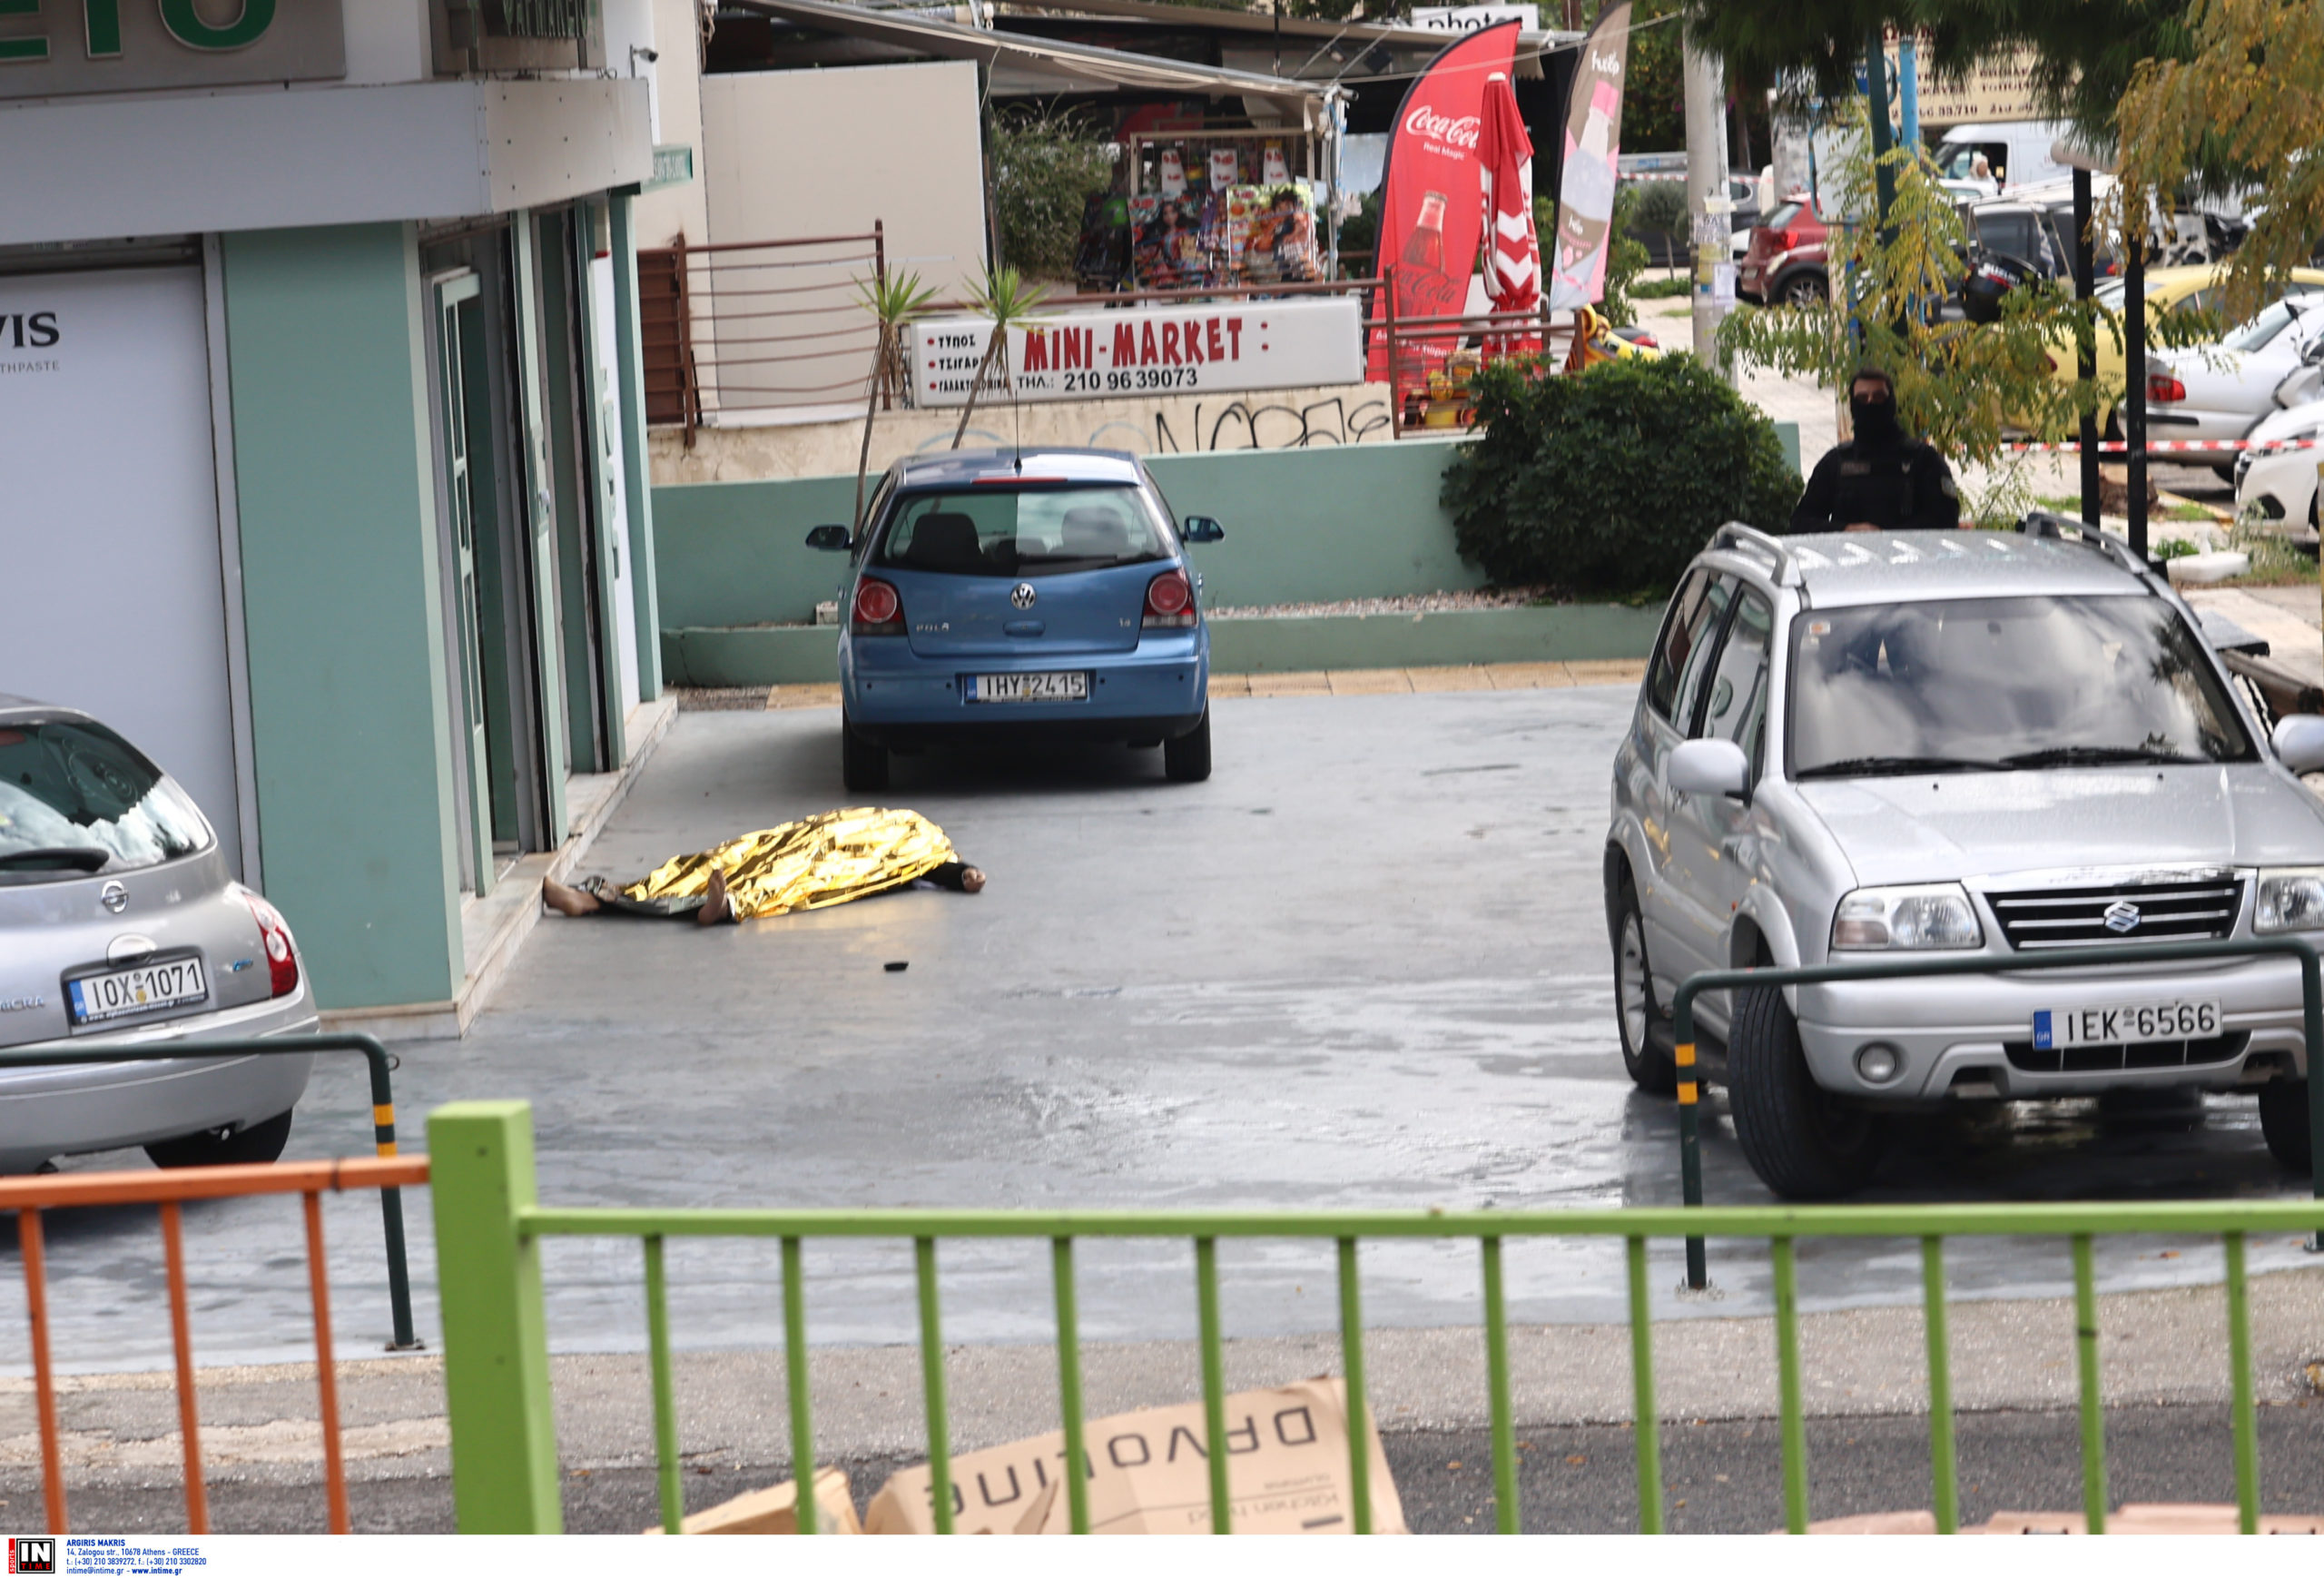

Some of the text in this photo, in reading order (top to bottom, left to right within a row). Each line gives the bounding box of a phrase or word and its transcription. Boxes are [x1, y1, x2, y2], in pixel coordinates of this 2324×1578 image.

[1405, 104, 1482, 150] Coca-Col
[1423, 141, 1465, 162] Real Magic
[1064, 371, 1101, 392] 210
[2036, 1031, 2050, 1041] GR
